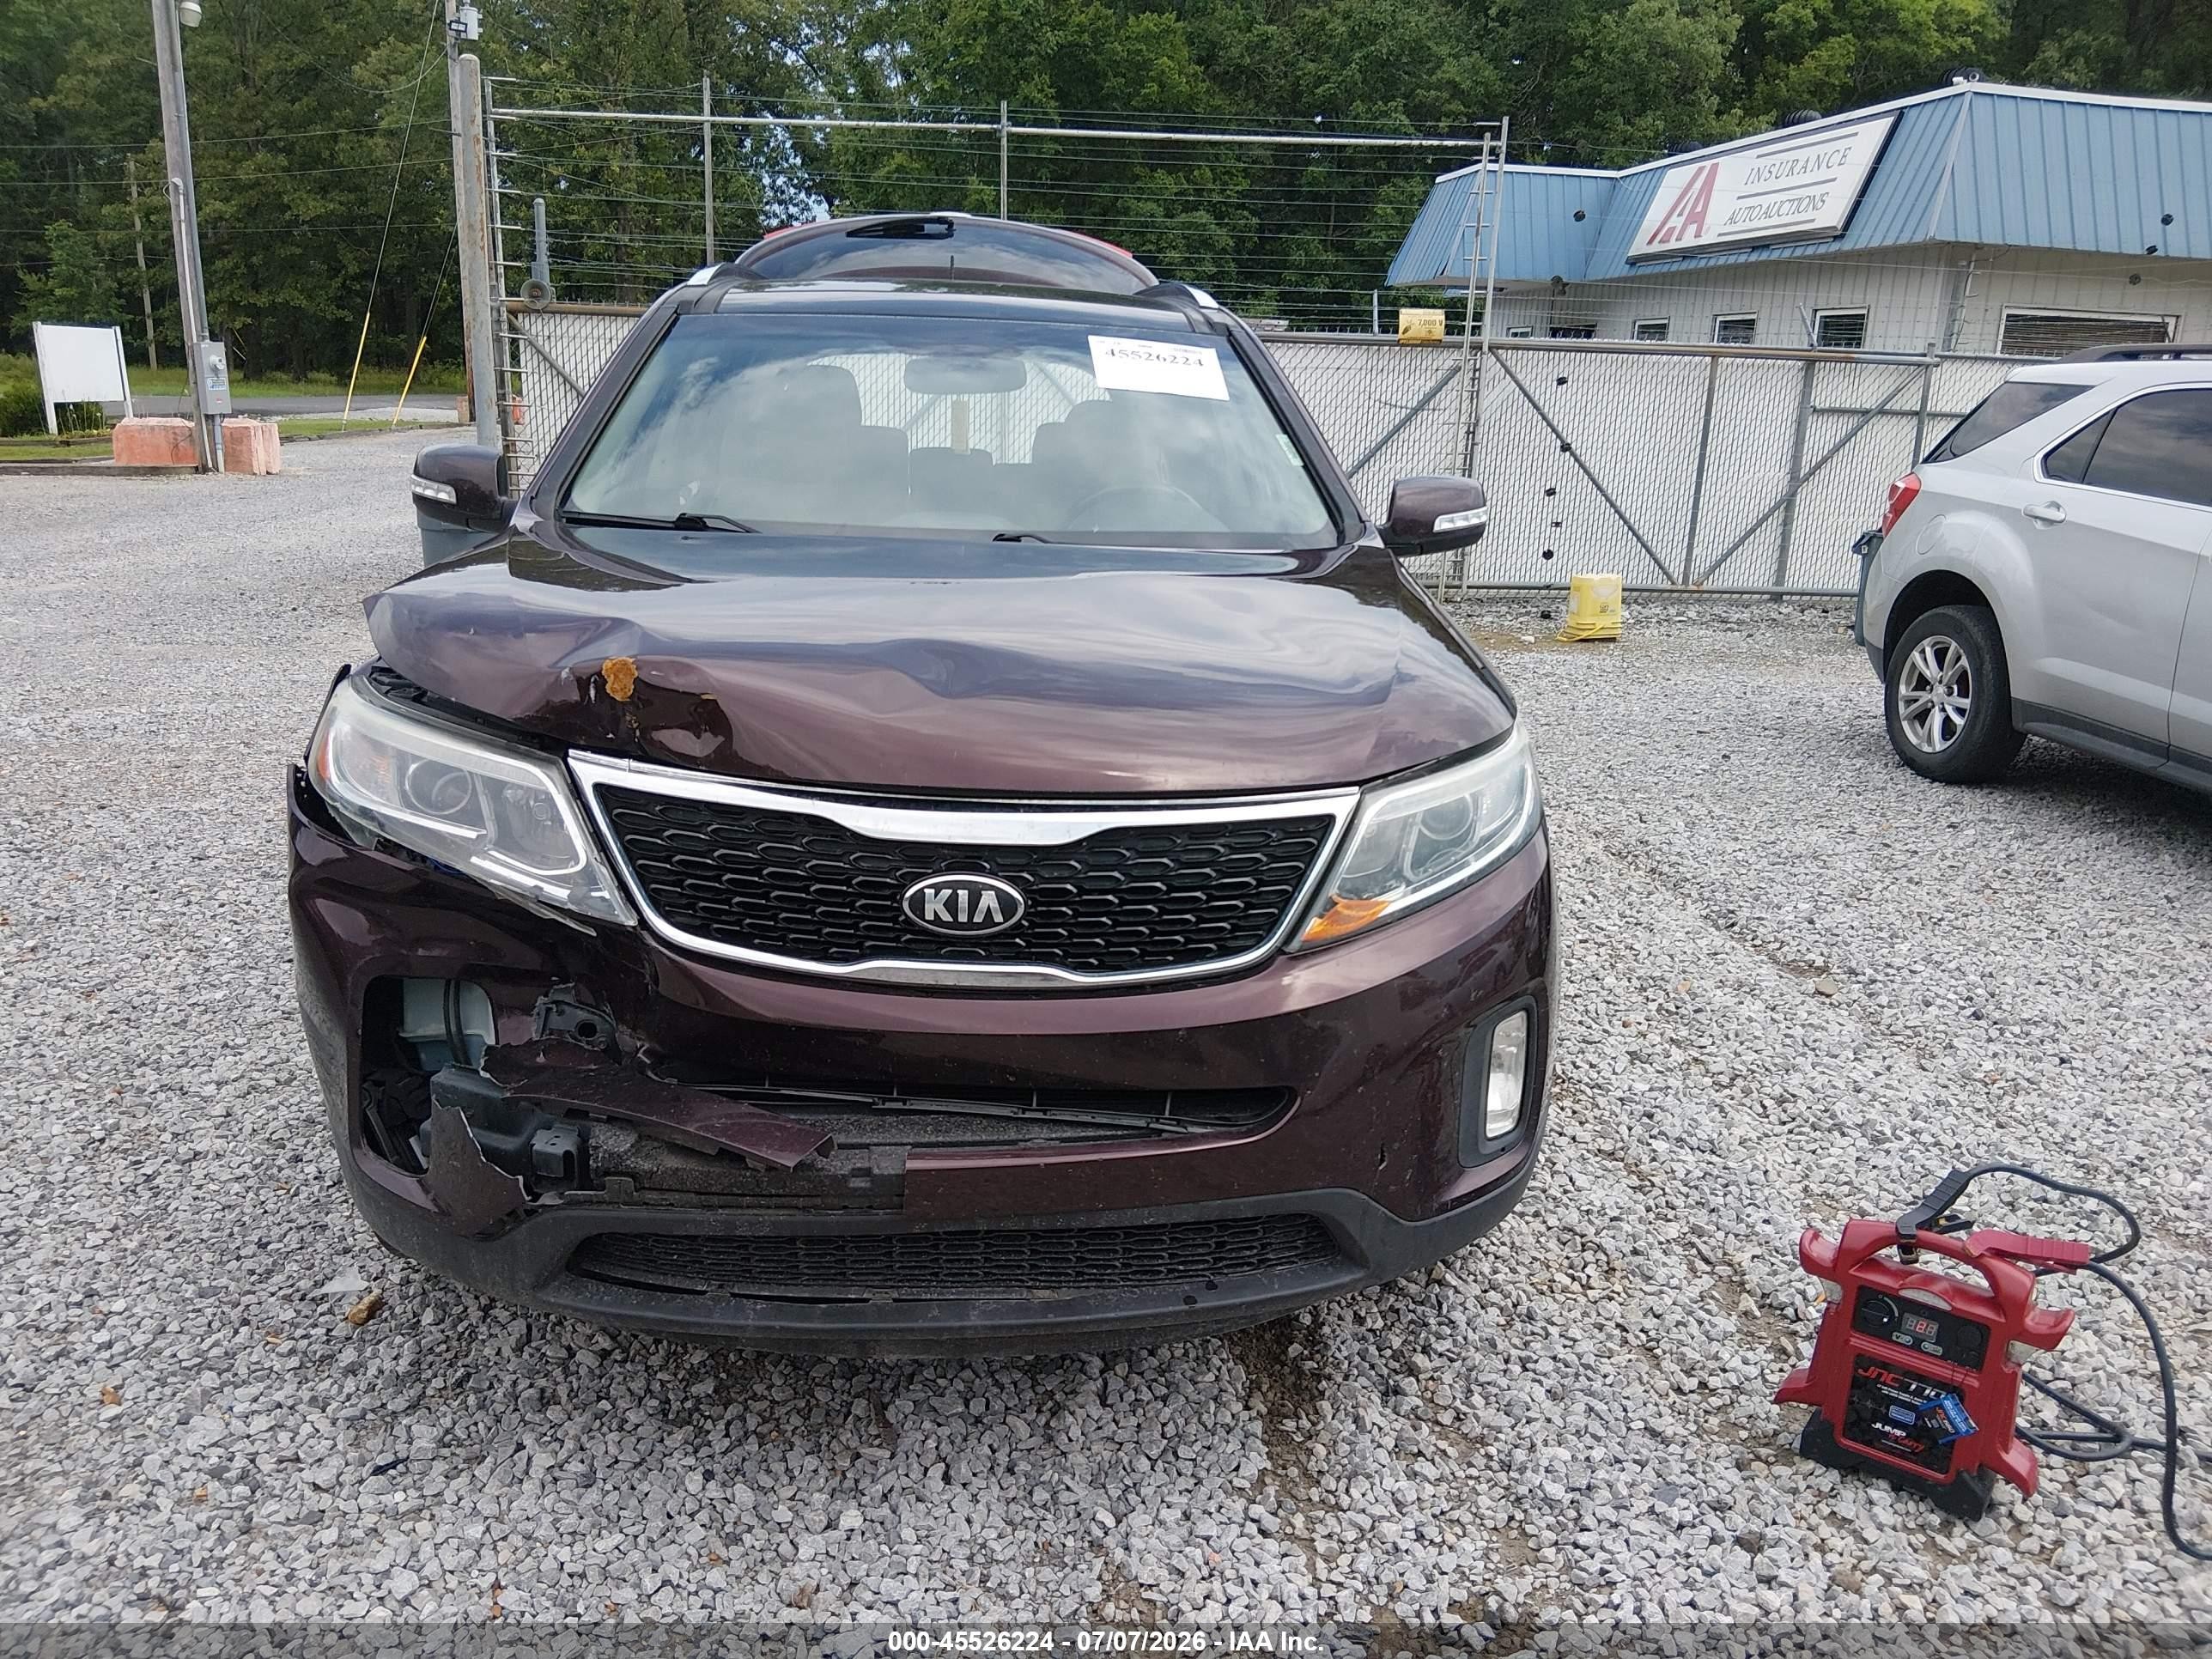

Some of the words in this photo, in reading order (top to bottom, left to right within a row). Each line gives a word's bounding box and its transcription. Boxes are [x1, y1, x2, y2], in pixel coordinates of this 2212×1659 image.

[1744, 146, 1853, 185] INSURANCE
[1724, 203, 1762, 226] AUTO
[1759, 191, 1830, 220] AUCTIONS
[1105, 348, 1204, 367] 45526224
[923, 888, 1004, 923] KIA
[1871, 1422, 1906, 1437] JUMP
